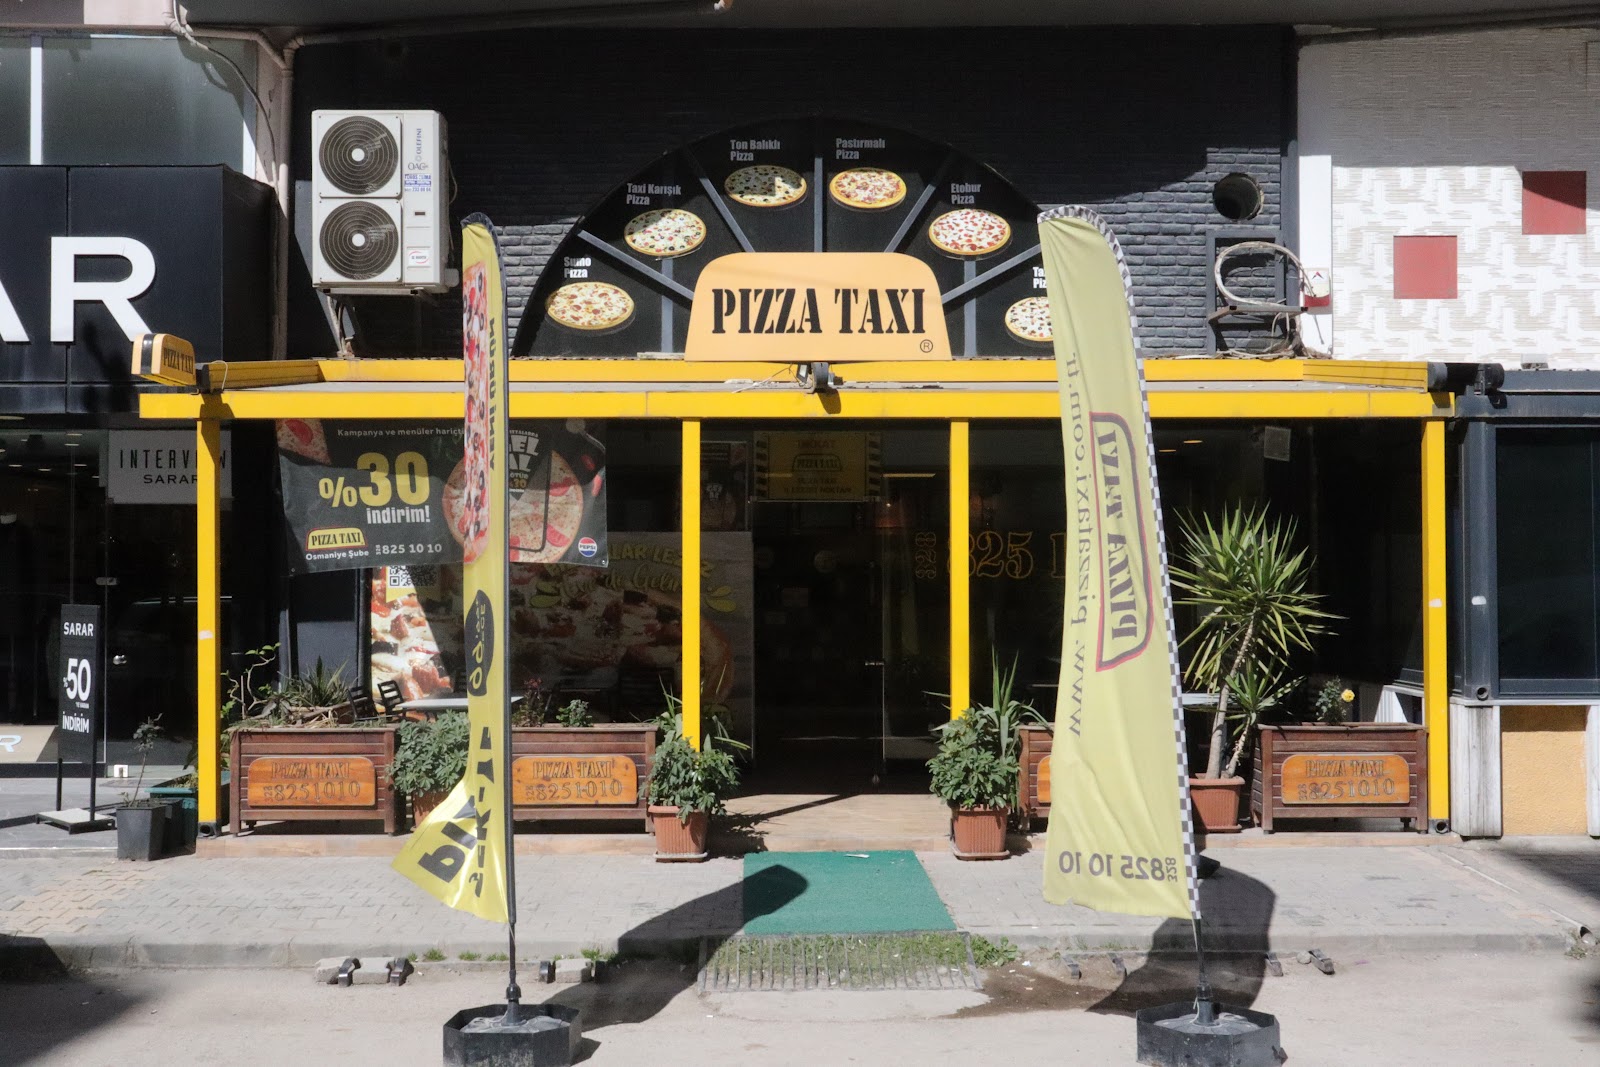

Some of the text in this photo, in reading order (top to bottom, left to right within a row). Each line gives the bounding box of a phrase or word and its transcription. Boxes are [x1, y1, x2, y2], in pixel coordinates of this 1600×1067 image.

[730, 139, 781, 150] Ton Balıklı
[835, 138, 886, 149] Pastırmalı
[730, 151, 754, 162] Pizza
[835, 149, 860, 160] Pizza
[626, 183, 682, 196] Taxi Karışık
[950, 183, 982, 194] Etobur
[626, 195, 650, 206] Pizza
[951, 194, 975, 205] Pizza
[563, 256, 592, 267] Sumo
[563, 268, 588, 278] Pizza
[1032, 266, 1045, 278] Ta
[1032, 277, 1048, 289] Piz
[711, 288, 926, 335] PIZZA TAXI
[337, 428, 383, 438] Kampanya
[385, 429, 396, 437] ve
[397, 428, 434, 437] menüler
[318, 451, 431, 508] %30
[366, 504, 431, 525] indirim!
[311, 532, 361, 546] PIZZA TAXI
[305, 549, 370, 561] Osmaniye Şube
[382, 544, 406, 555] 825
[409, 543, 424, 554] 10
[427, 543, 443, 554] 10
[63, 621, 94, 638] SARAR
[62, 657, 92, 702] %50
[62, 711, 90, 734] İNDİRİM
[270, 761, 351, 780] PIZZA TAXI
[532, 760, 612, 779] PIZZA TAXI
[1305, 759, 1386, 778] PIZZA TAXI
